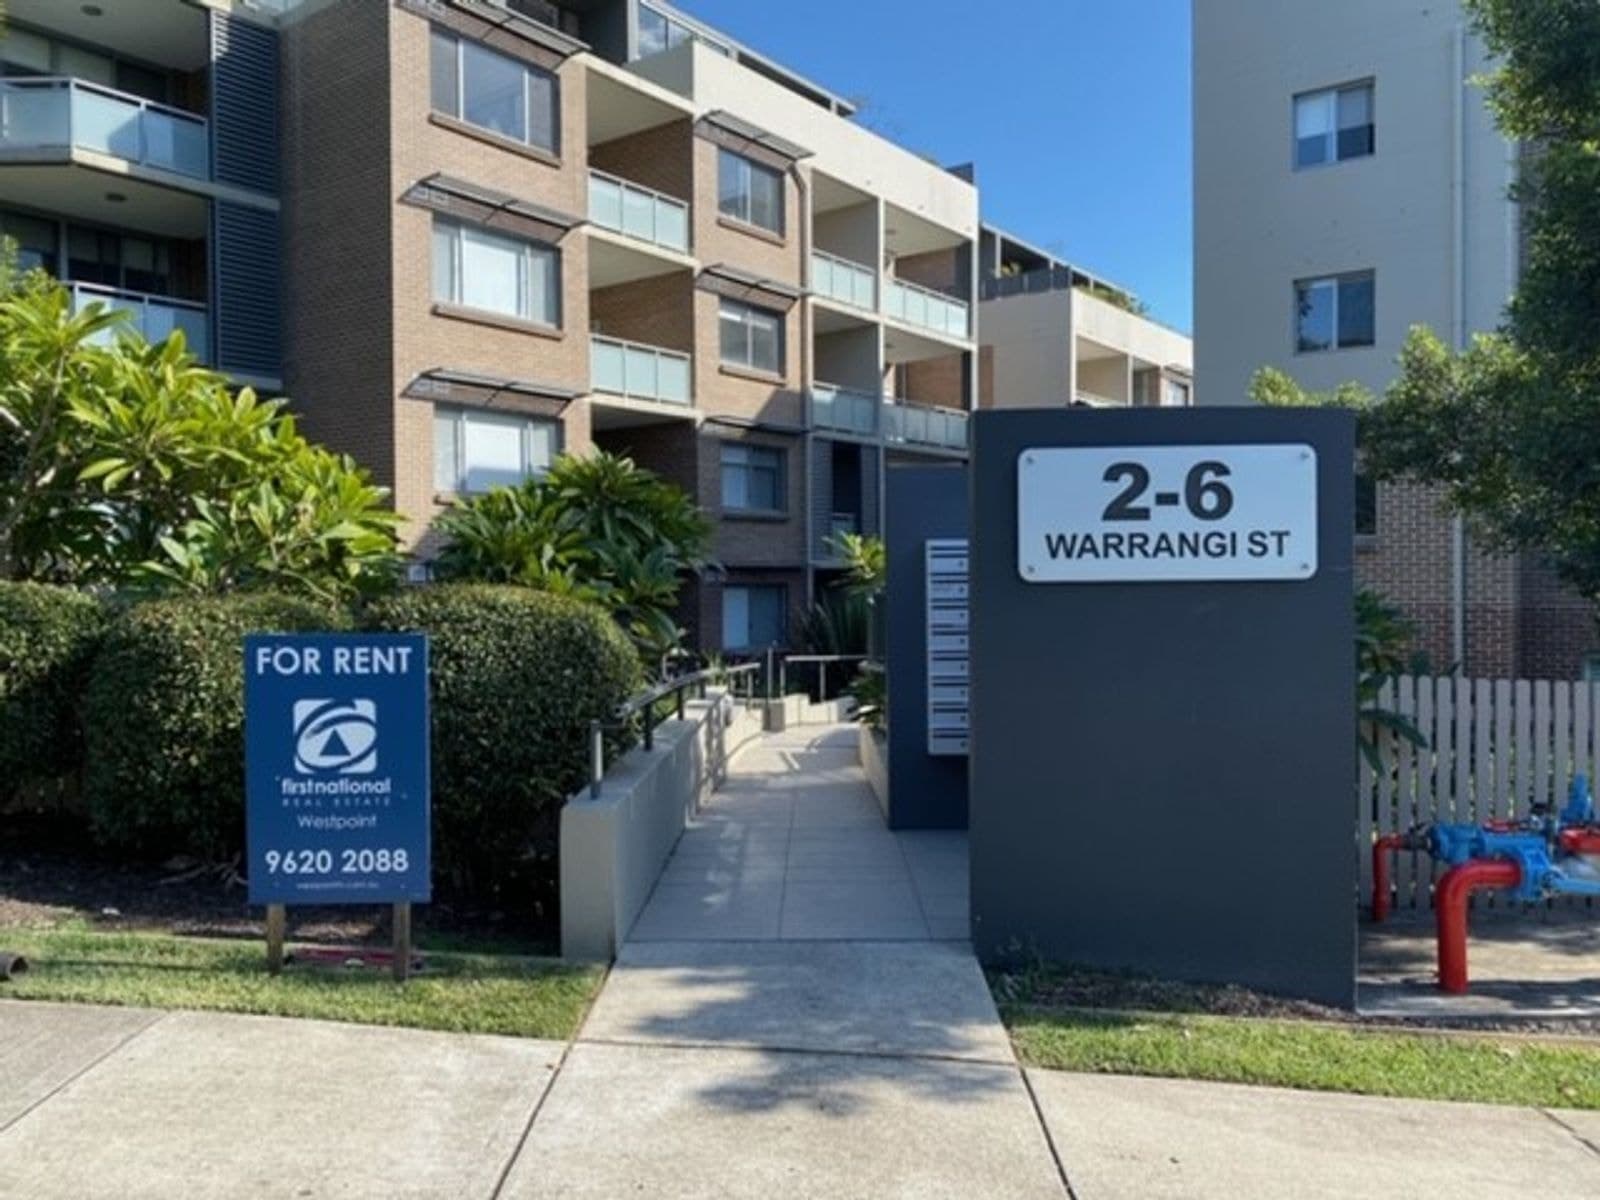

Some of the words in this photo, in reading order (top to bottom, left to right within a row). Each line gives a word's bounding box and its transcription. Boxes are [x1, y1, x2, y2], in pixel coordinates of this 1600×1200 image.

[1101, 460, 1234, 521] 2-6
[1045, 531, 1237, 559] WARRANGI
[1247, 530, 1291, 557] ST
[256, 646, 321, 675] FOR
[333, 646, 412, 674] RENT
[297, 814, 377, 830] Westpoint
[265, 850, 332, 874] 9620
[341, 848, 409, 873] 2088
